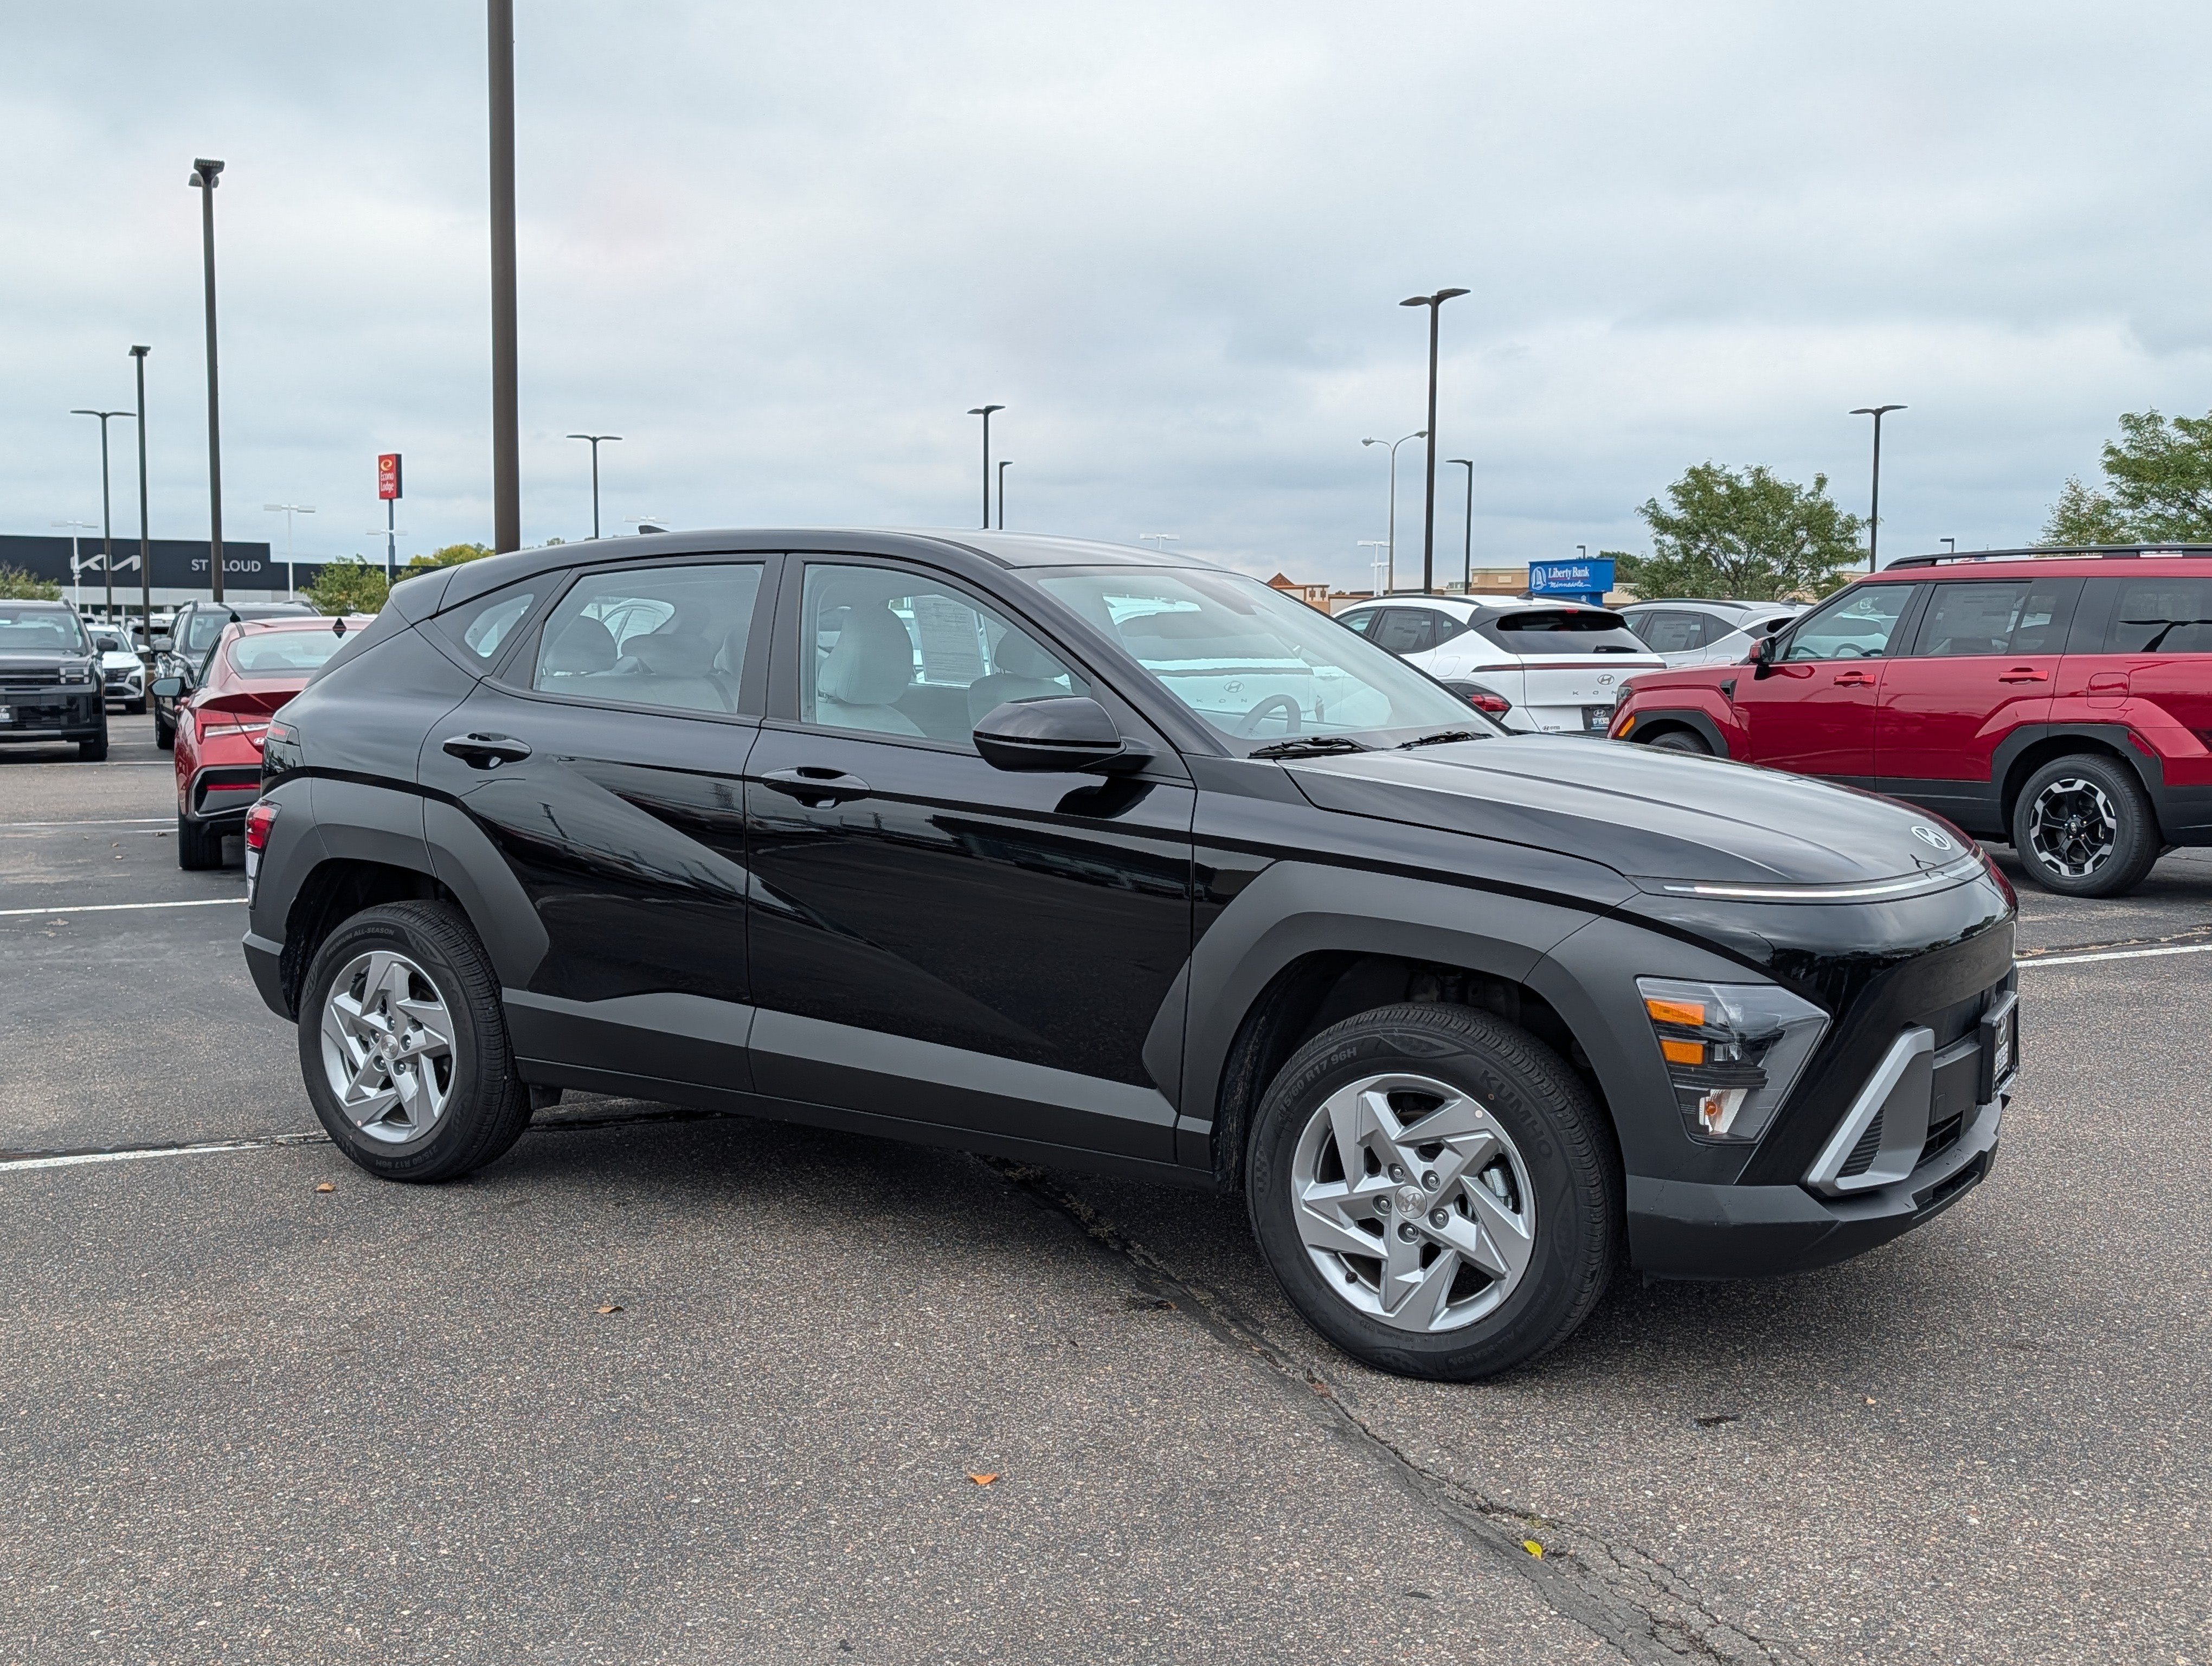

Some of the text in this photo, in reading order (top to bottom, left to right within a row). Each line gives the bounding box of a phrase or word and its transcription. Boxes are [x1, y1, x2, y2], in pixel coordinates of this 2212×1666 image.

[222, 559, 261, 572] LOUD
[1548, 566, 1590, 580] Liberty Bank
[353, 927, 395, 937] ALL-SEASON
[1304, 1059, 1328, 1082] R17
[1330, 1046, 1358, 1065] 96H
[1479, 1069, 1553, 1159] KUMHO
